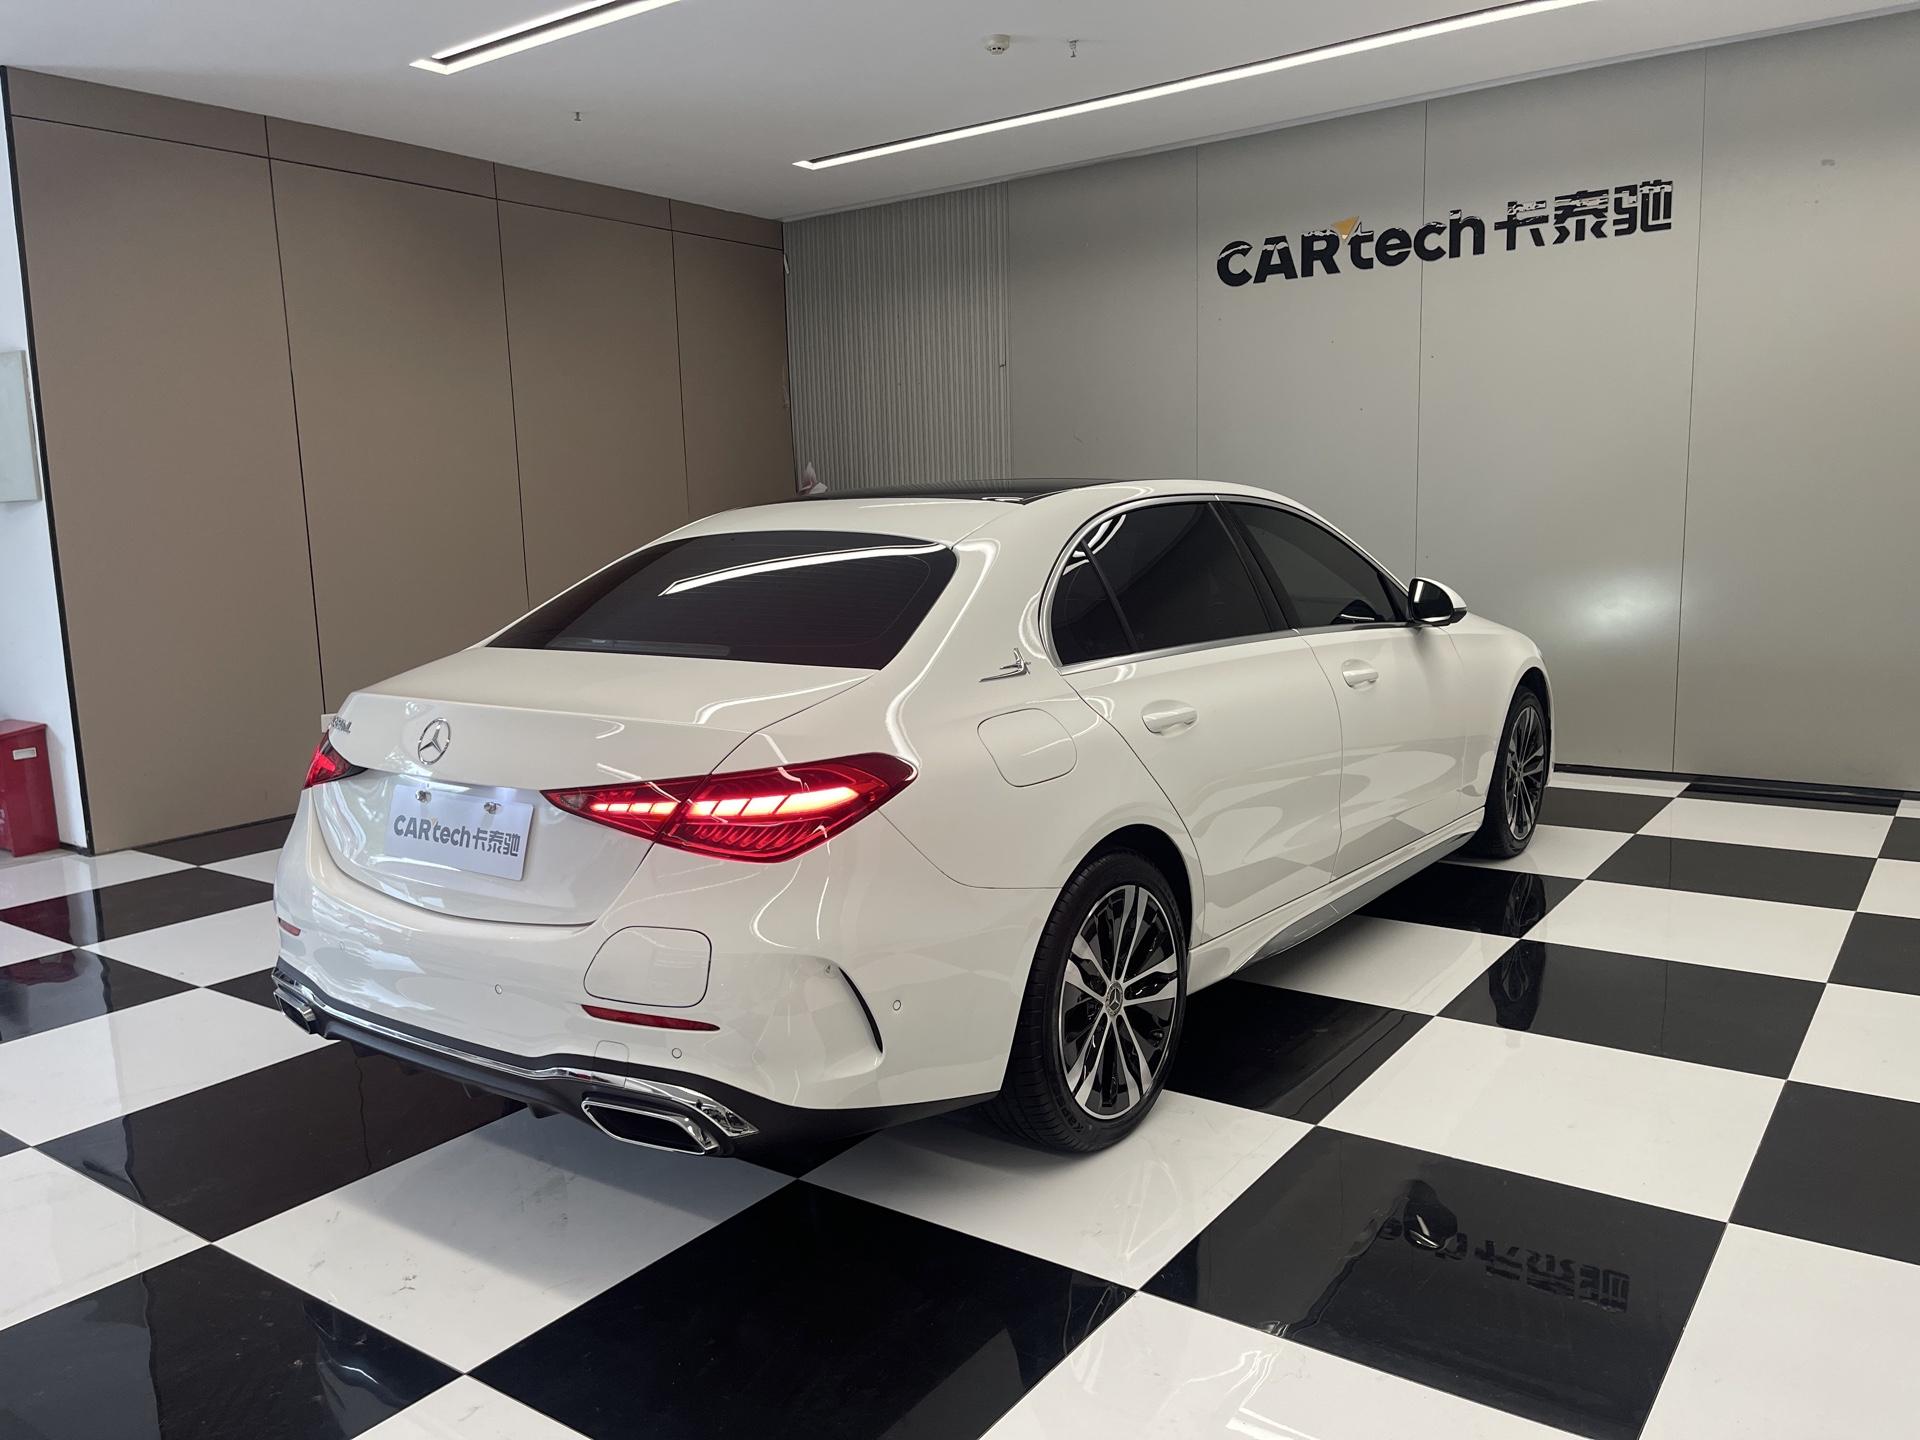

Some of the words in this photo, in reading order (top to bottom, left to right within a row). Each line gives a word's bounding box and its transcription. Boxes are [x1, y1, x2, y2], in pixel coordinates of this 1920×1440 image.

[1216, 208, 1485, 287] CARtech
[1494, 179, 1673, 251] 卡泰驰
[393, 814, 471, 848] CARtech
[472, 827, 521, 857] 卡泰驰
